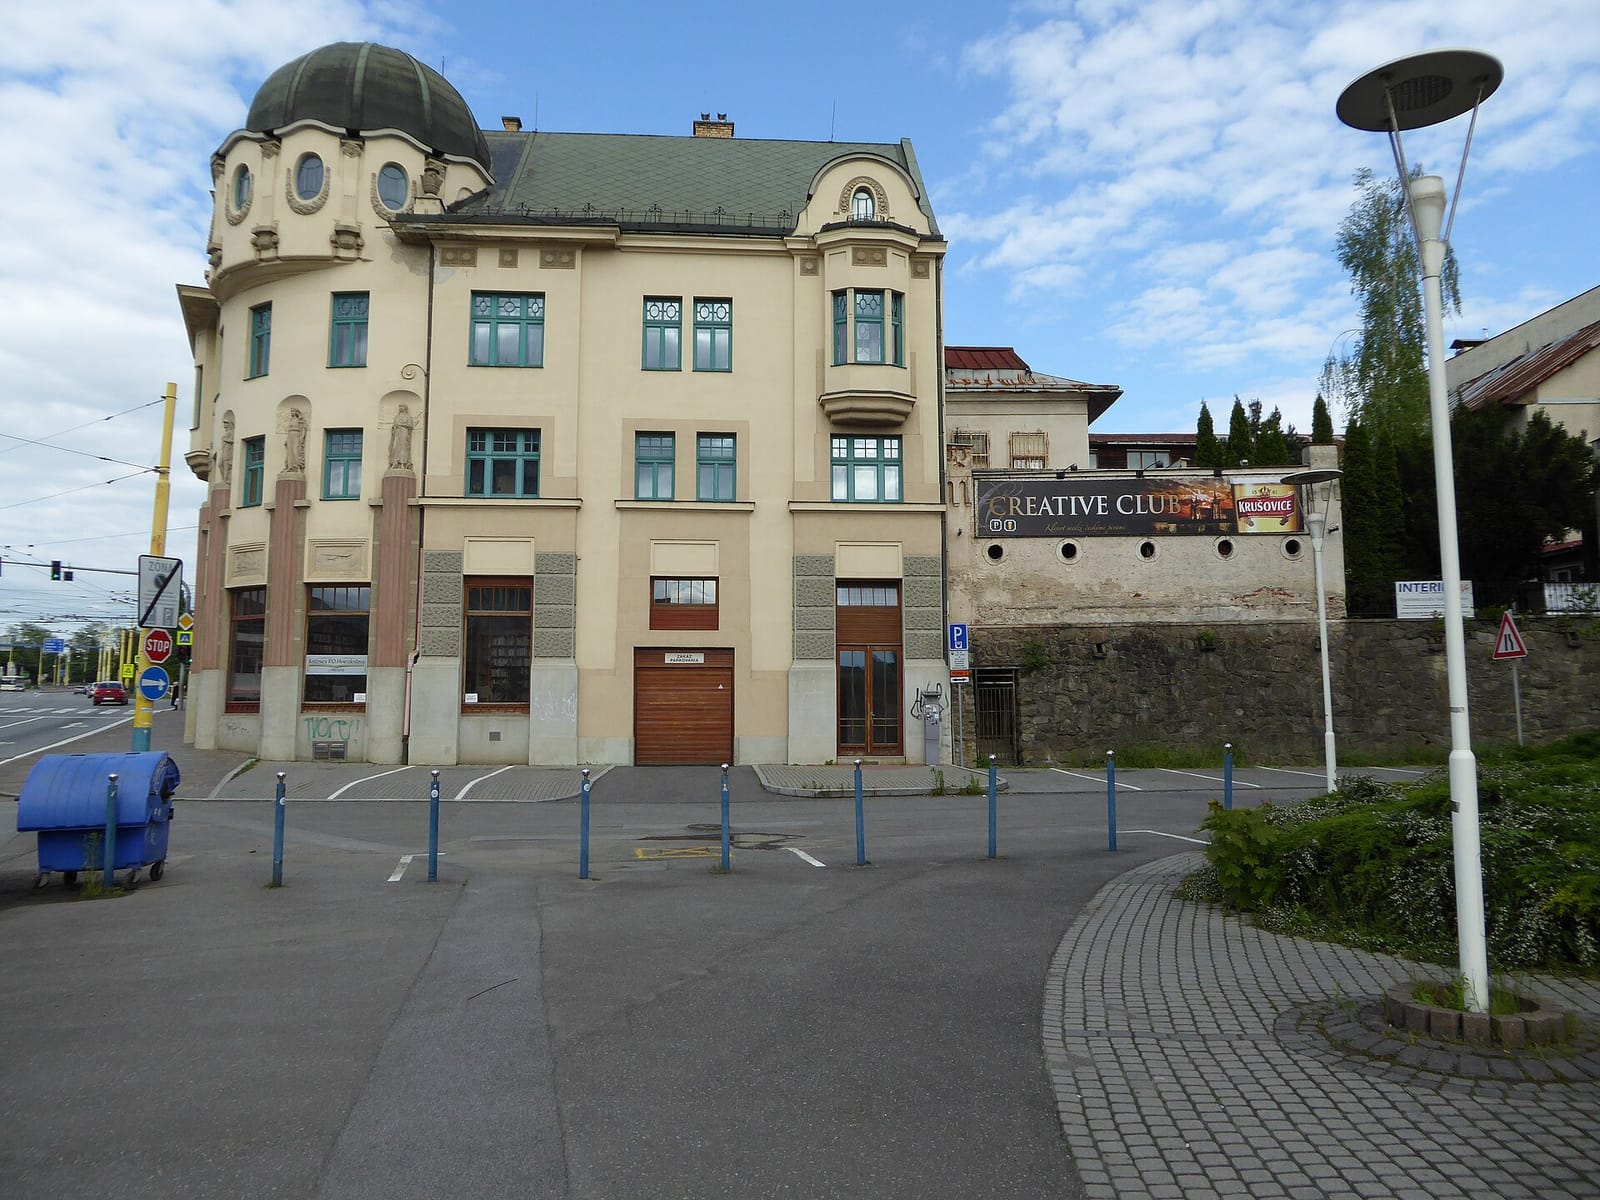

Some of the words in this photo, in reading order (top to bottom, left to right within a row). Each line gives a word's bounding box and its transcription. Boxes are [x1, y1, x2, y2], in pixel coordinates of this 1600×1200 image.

[989, 495, 1109, 516] CREATIVE
[1116, 494, 1181, 515] CLUB
[1238, 499, 1292, 513] KRUŠOVICE
[146, 638, 170, 653] STOP
